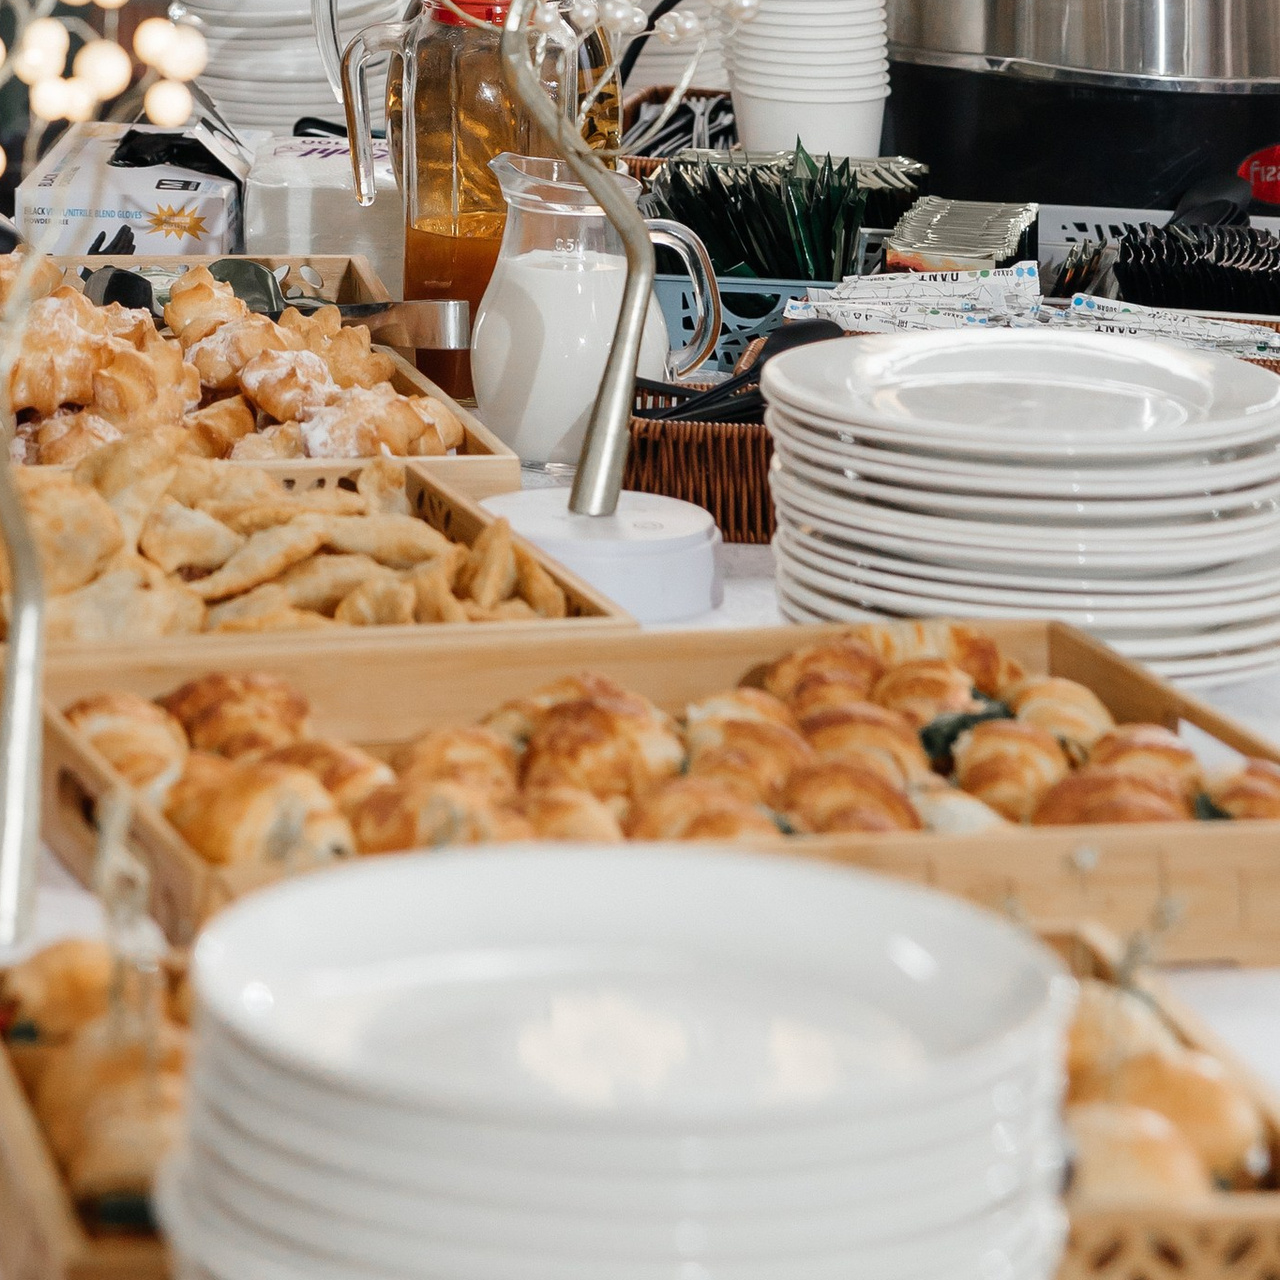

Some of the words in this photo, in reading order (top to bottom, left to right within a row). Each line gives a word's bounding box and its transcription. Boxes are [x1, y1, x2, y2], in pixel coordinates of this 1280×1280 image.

[94, 208, 116, 219] BLEND
[117, 210, 143, 220] GLOVES
[1096, 303, 1118, 314] SUGAR
